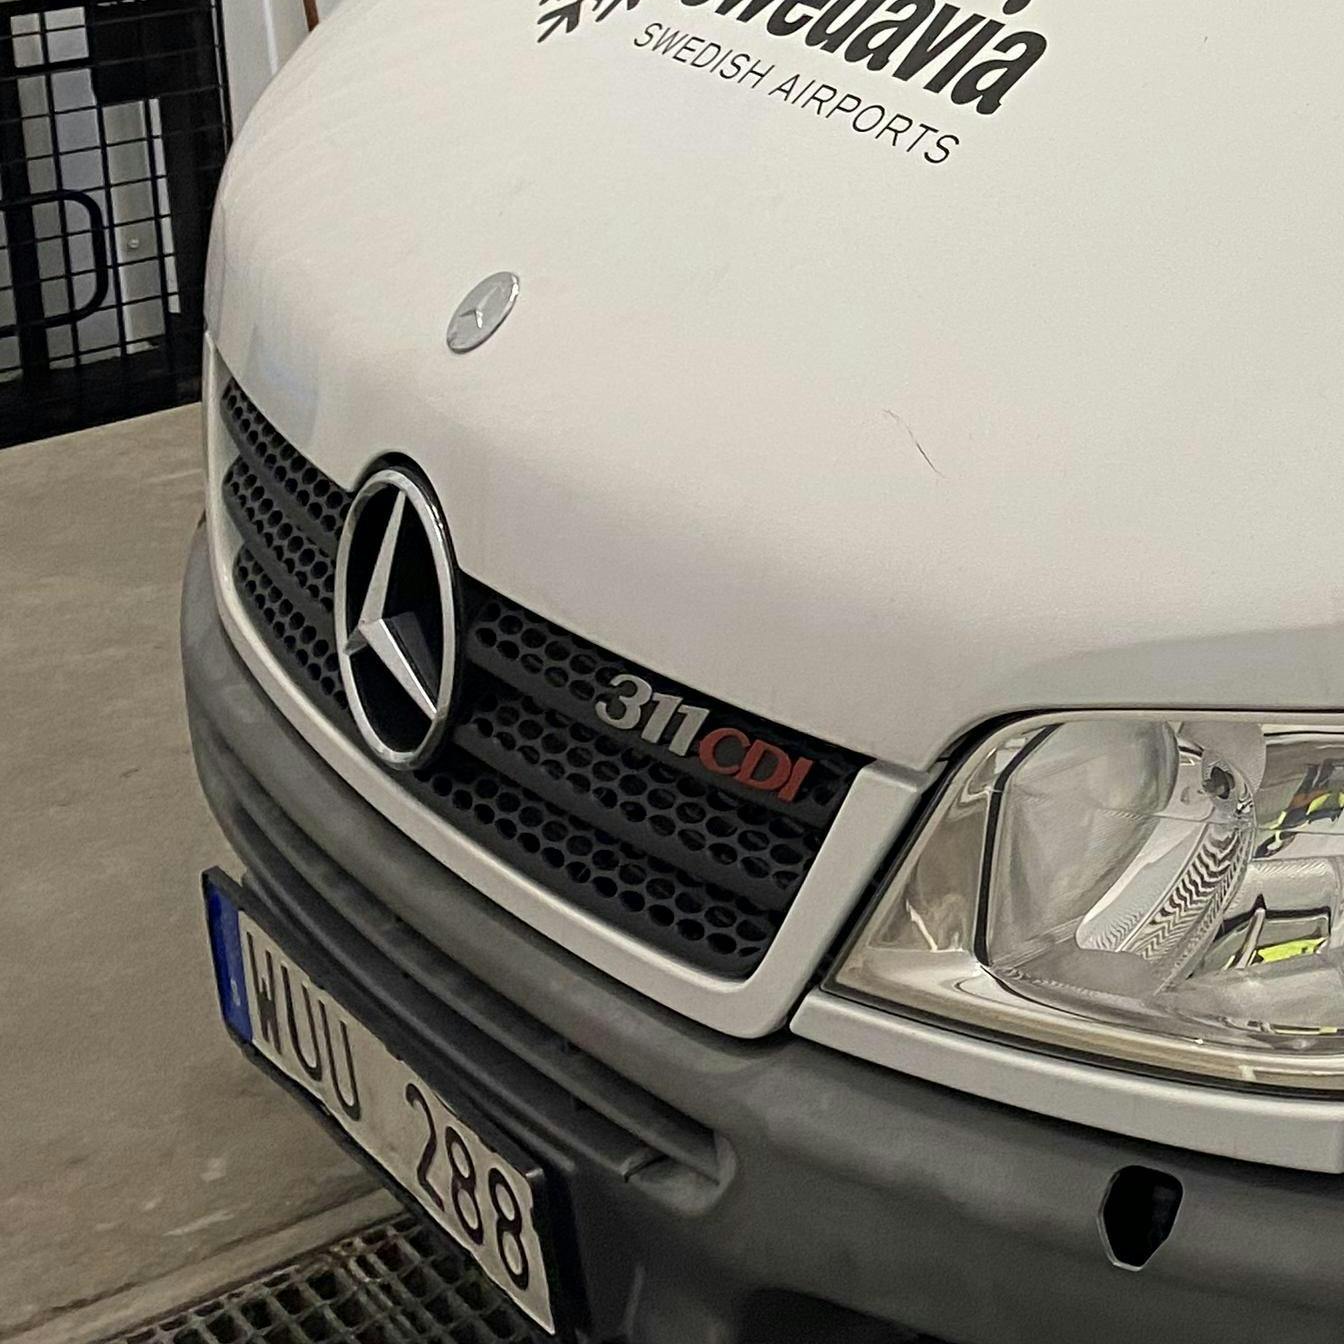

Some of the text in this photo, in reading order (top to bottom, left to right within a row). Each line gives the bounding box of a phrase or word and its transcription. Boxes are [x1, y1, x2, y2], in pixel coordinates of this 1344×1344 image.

[633, 21, 960, 165] SWEDISH AIRPORTS
[244, 929, 531, 1293] WUU 288
